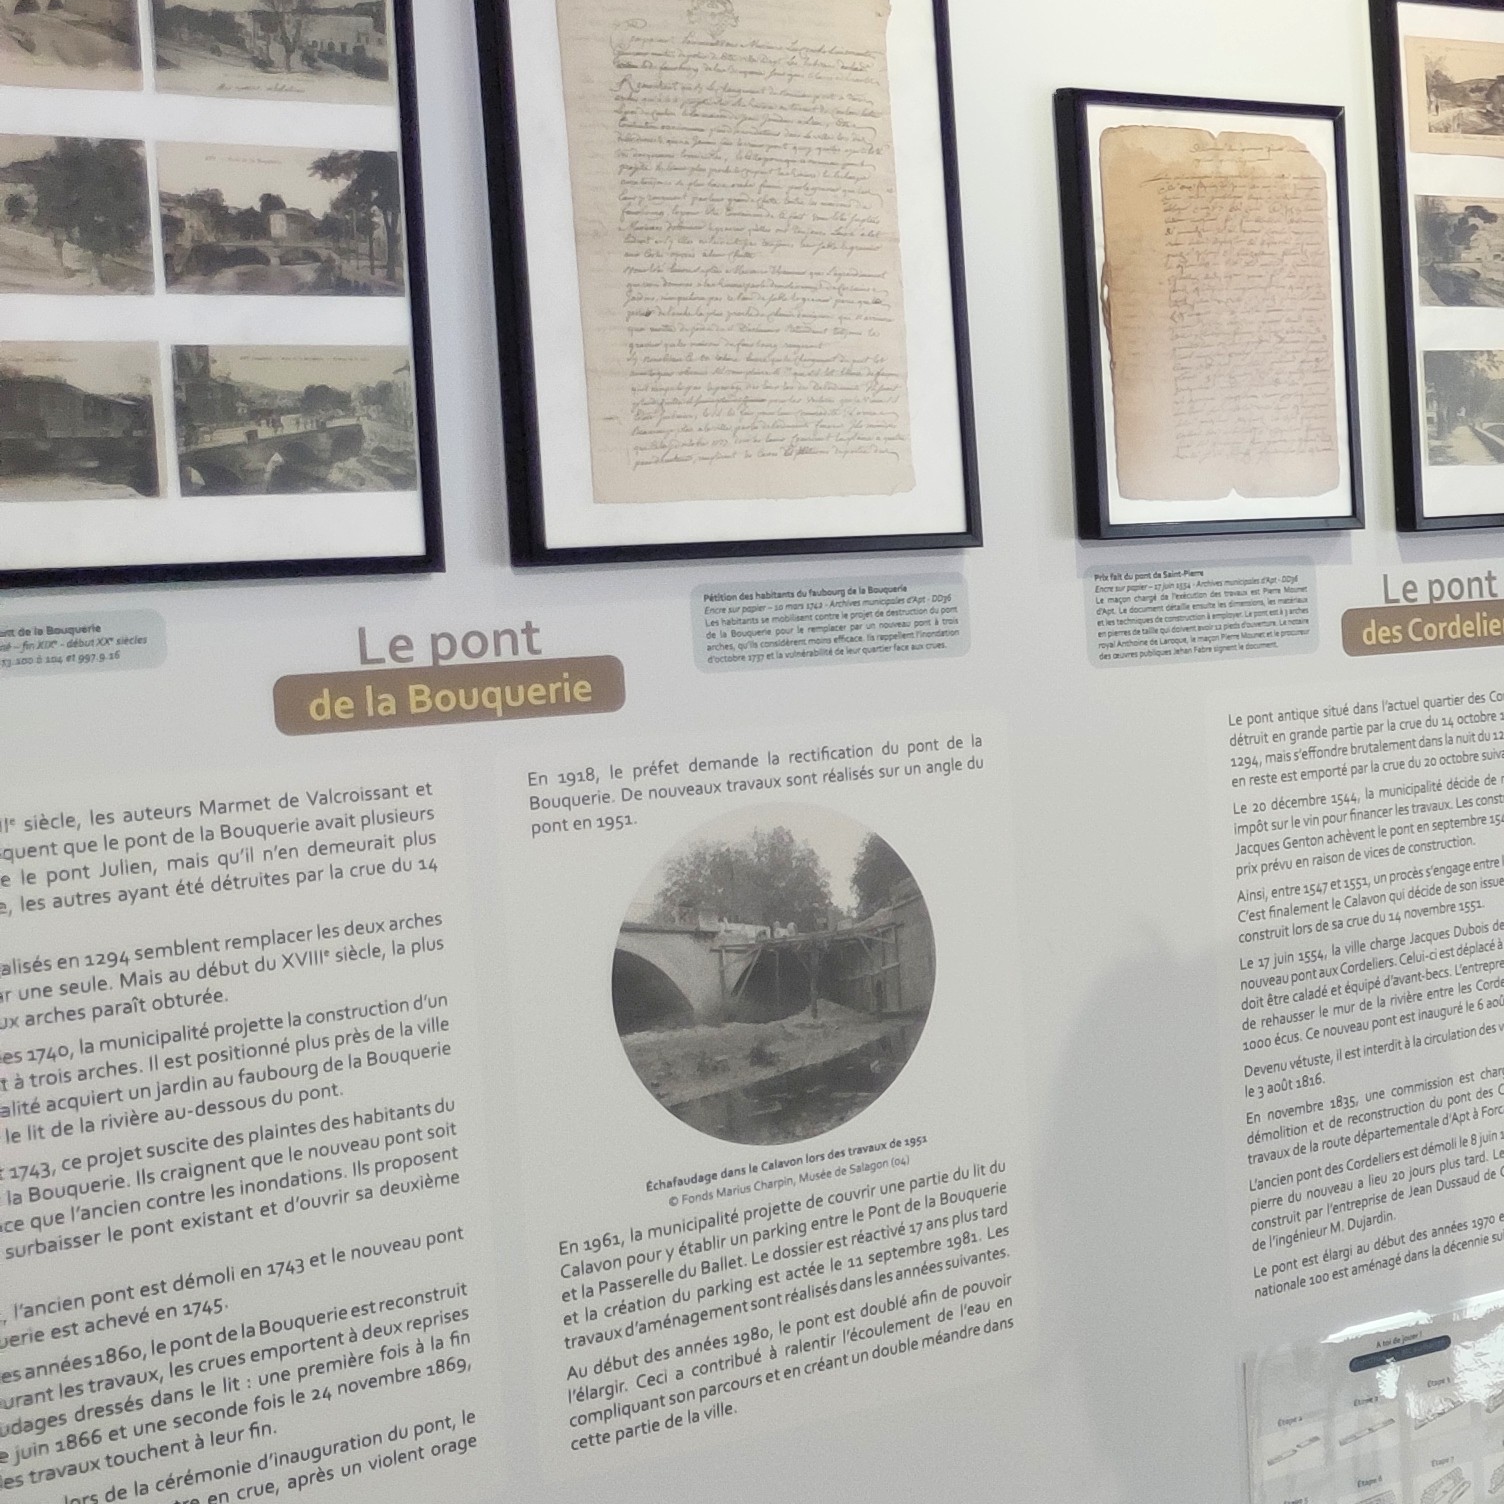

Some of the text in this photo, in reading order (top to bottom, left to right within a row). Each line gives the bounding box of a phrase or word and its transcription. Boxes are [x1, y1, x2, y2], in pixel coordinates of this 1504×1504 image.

[1383, 570, 1498, 604] Le pont
[358, 620, 542, 665] Le pont
[1362, 618, 1402, 645] des
[309, 672, 592, 721] de la Bouquerie
[1228, 714, 1242, 726] Le
[1246, 711, 1274, 728] pont
[1277, 708, 1319, 723] antique
[1322, 702, 1349, 718] situé
[1352, 701, 1378, 714] dans
[1422, 695, 1464, 711] quartier
[1467, 691, 1486, 704] des
[527, 733, 982, 787] En 1918, le préfet demande la rectification du pont de la
[531, 814, 637, 838] pont en 1951.
[646, 1135, 927, 1192] Échafaudage dans le Calavon lors des travaux de 1951
